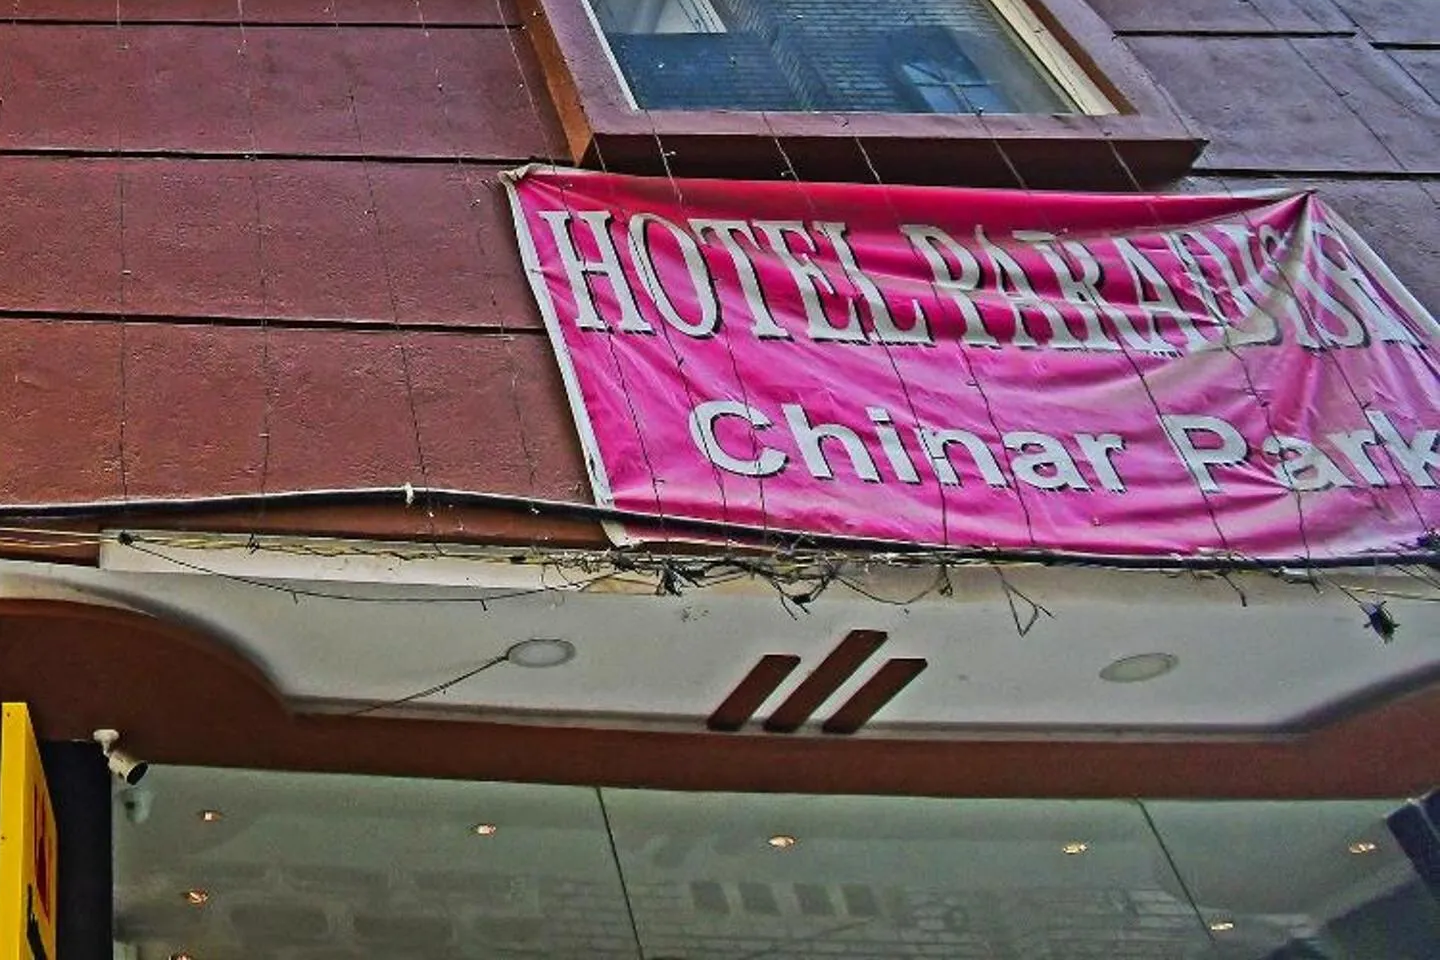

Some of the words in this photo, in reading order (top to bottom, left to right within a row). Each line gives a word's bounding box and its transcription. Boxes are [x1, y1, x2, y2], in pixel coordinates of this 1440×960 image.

[539, 209, 934, 346] HOTEL
[688, 399, 1127, 494] Chinar
[1156, 408, 1440, 494] Park
